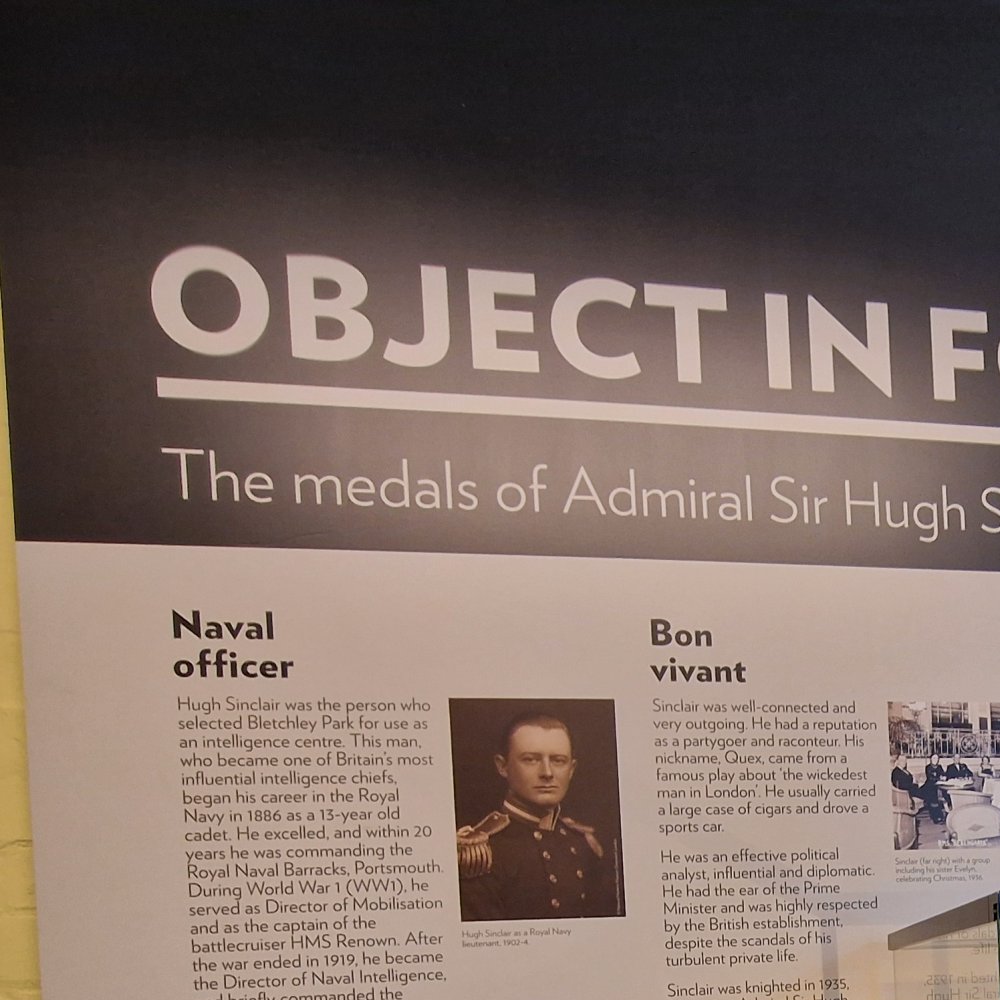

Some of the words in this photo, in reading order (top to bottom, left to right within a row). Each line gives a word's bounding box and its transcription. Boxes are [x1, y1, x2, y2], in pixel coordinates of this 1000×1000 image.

[151, 245, 727, 383] OBJECT
[764, 293, 892, 398] IN
[161, 447, 274, 503] The
[294, 459, 478, 510] medals
[497, 464, 547, 512] of
[563, 466, 752, 521] Admiral
[771, 476, 828, 524] Sir
[845, 480, 965, 542] Hugh
[172, 610, 274, 640] Naval
[650, 619, 712, 647] Bon
[173, 648, 294, 678] officer
[650, 657, 746, 683] vivant
[177, 696, 221, 715] Hugh
[226, 696, 280, 711] Sinclair
[285, 702, 312, 711] was
[317, 697, 341, 711] the
[346, 702, 396, 716] person
[400, 697, 431, 711] who
[653, 698, 699, 712] Sinclair
[703, 704, 727, 713] was
[731, 699, 829, 713] well-connected
[832, 700, 856, 714] and
[178, 715, 242, 730] selected
[248, 714, 317, 733] Bletchley
[322, 714, 355, 730] Park
[359, 715, 379, 729] for
[384, 720, 408, 730] use
[413, 721, 428, 730] as
[653, 721, 682, 733] very
[685, 718, 748, 733] outgoing.
[752, 716, 771, 730] He
[775, 716, 798, 730] had
[802, 722, 809, 730] a
[813, 720, 877, 734] reputation
[462, 930, 483, 939] Hugh
[485, 929, 512, 938] Sinclair
[529, 928, 550, 937] Royal
[552, 928, 572, 936] Navy
